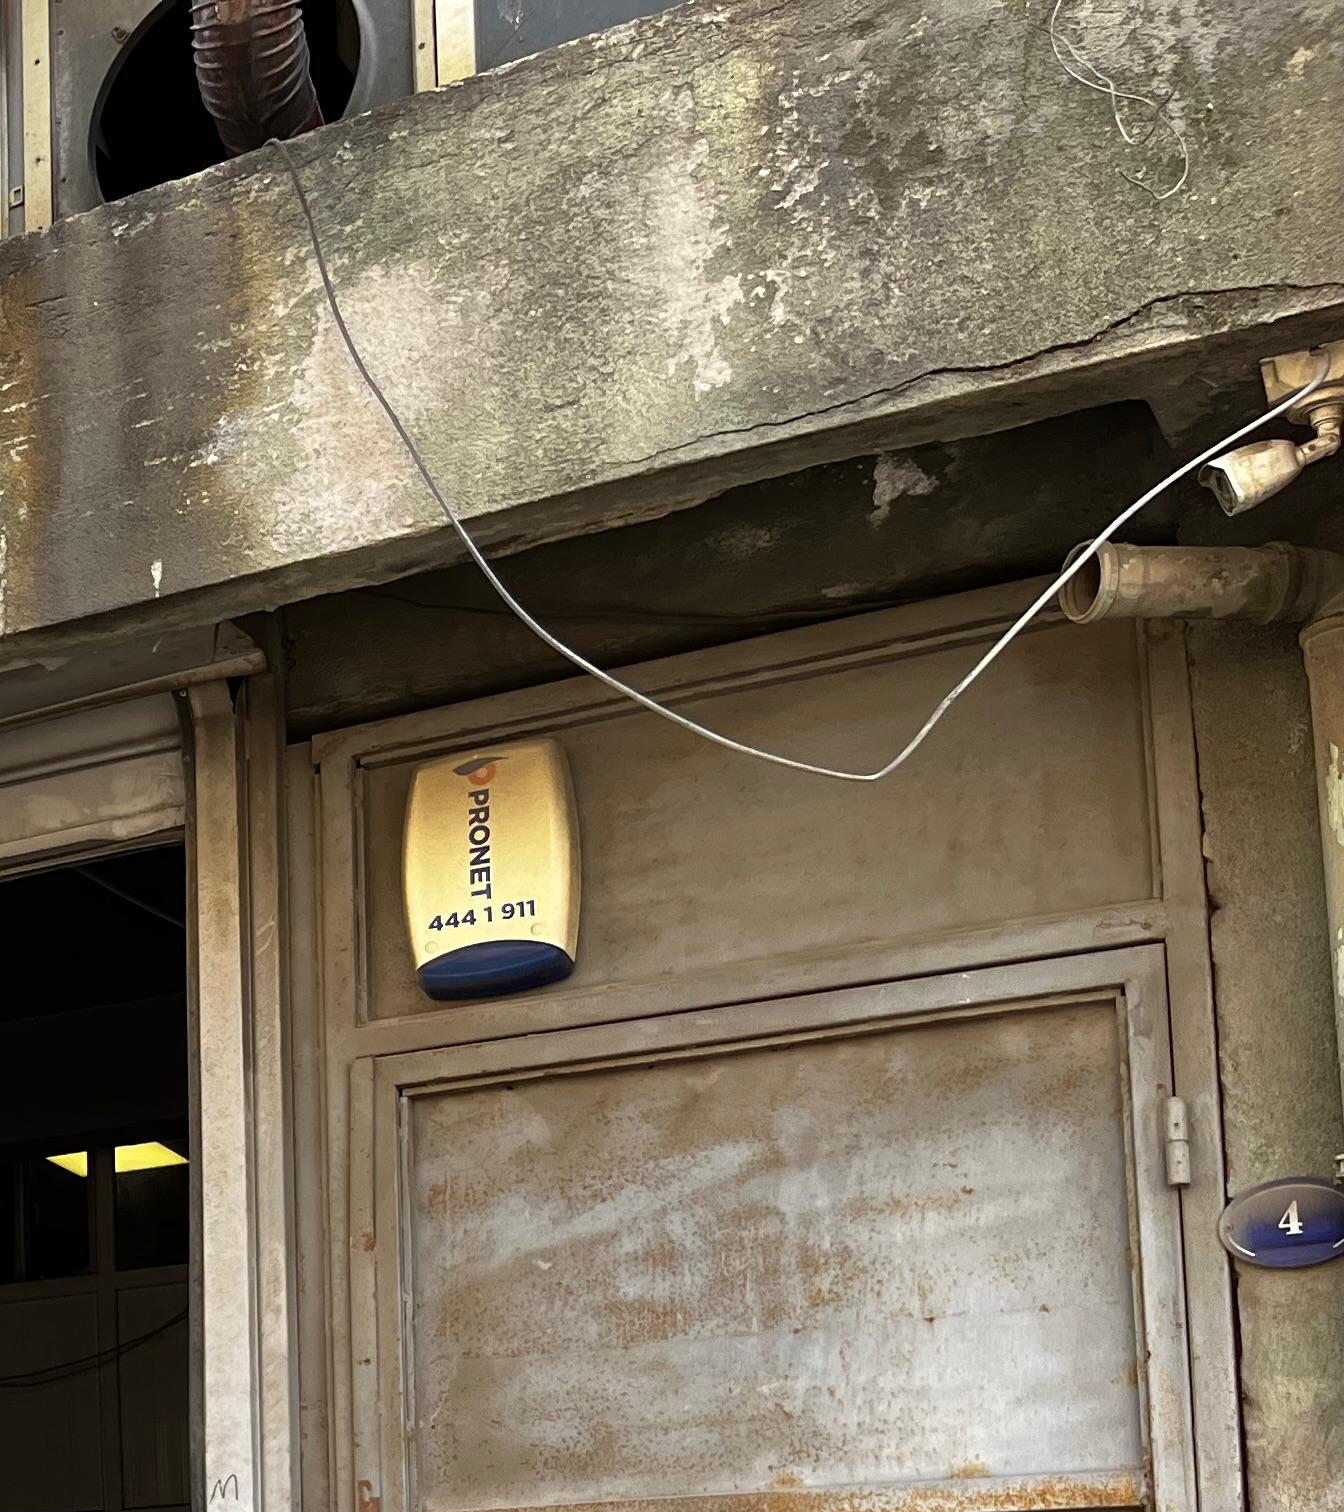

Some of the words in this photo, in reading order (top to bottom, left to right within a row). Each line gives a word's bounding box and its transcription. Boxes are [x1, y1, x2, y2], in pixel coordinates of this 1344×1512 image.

[468, 788, 492, 899] PRONET
[429, 909, 476, 931] 444
[484, 906, 493, 922] 1
[501, 899, 535, 919] 911
[1278, 1200, 1304, 1235] 4
